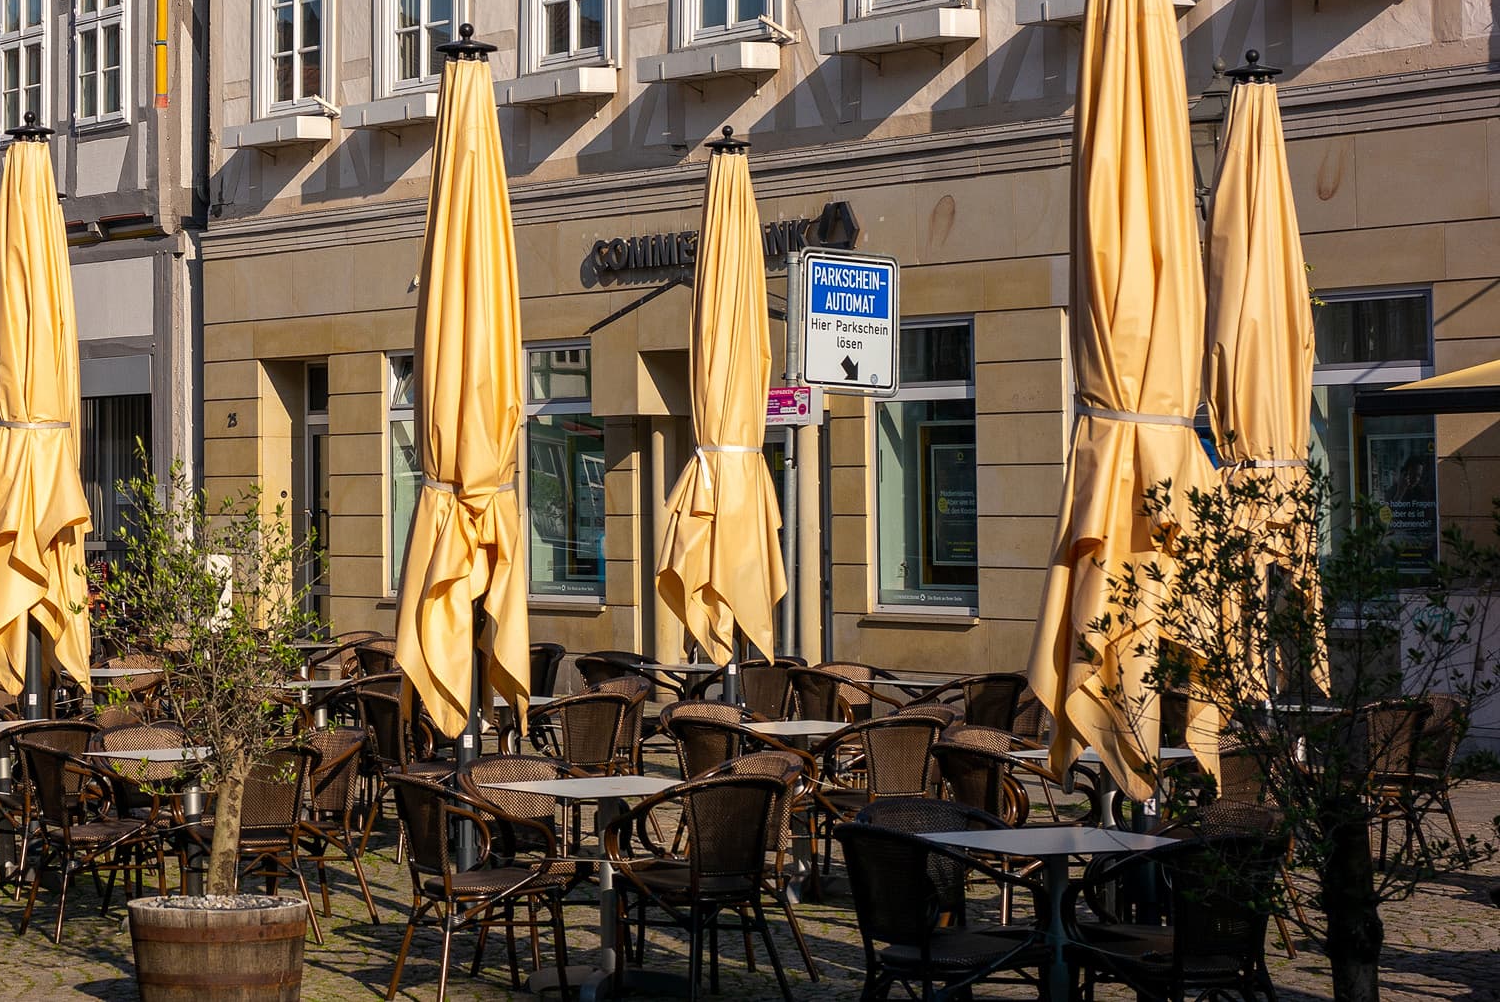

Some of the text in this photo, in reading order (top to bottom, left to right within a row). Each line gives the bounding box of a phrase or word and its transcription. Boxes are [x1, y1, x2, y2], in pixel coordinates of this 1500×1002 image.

[814, 266, 887, 291] PARKSCHEIN-
[825, 292, 875, 314] AUTOMAT
[811, 318, 889, 336] Hier Parkschein
[836, 336, 863, 350] lösen
